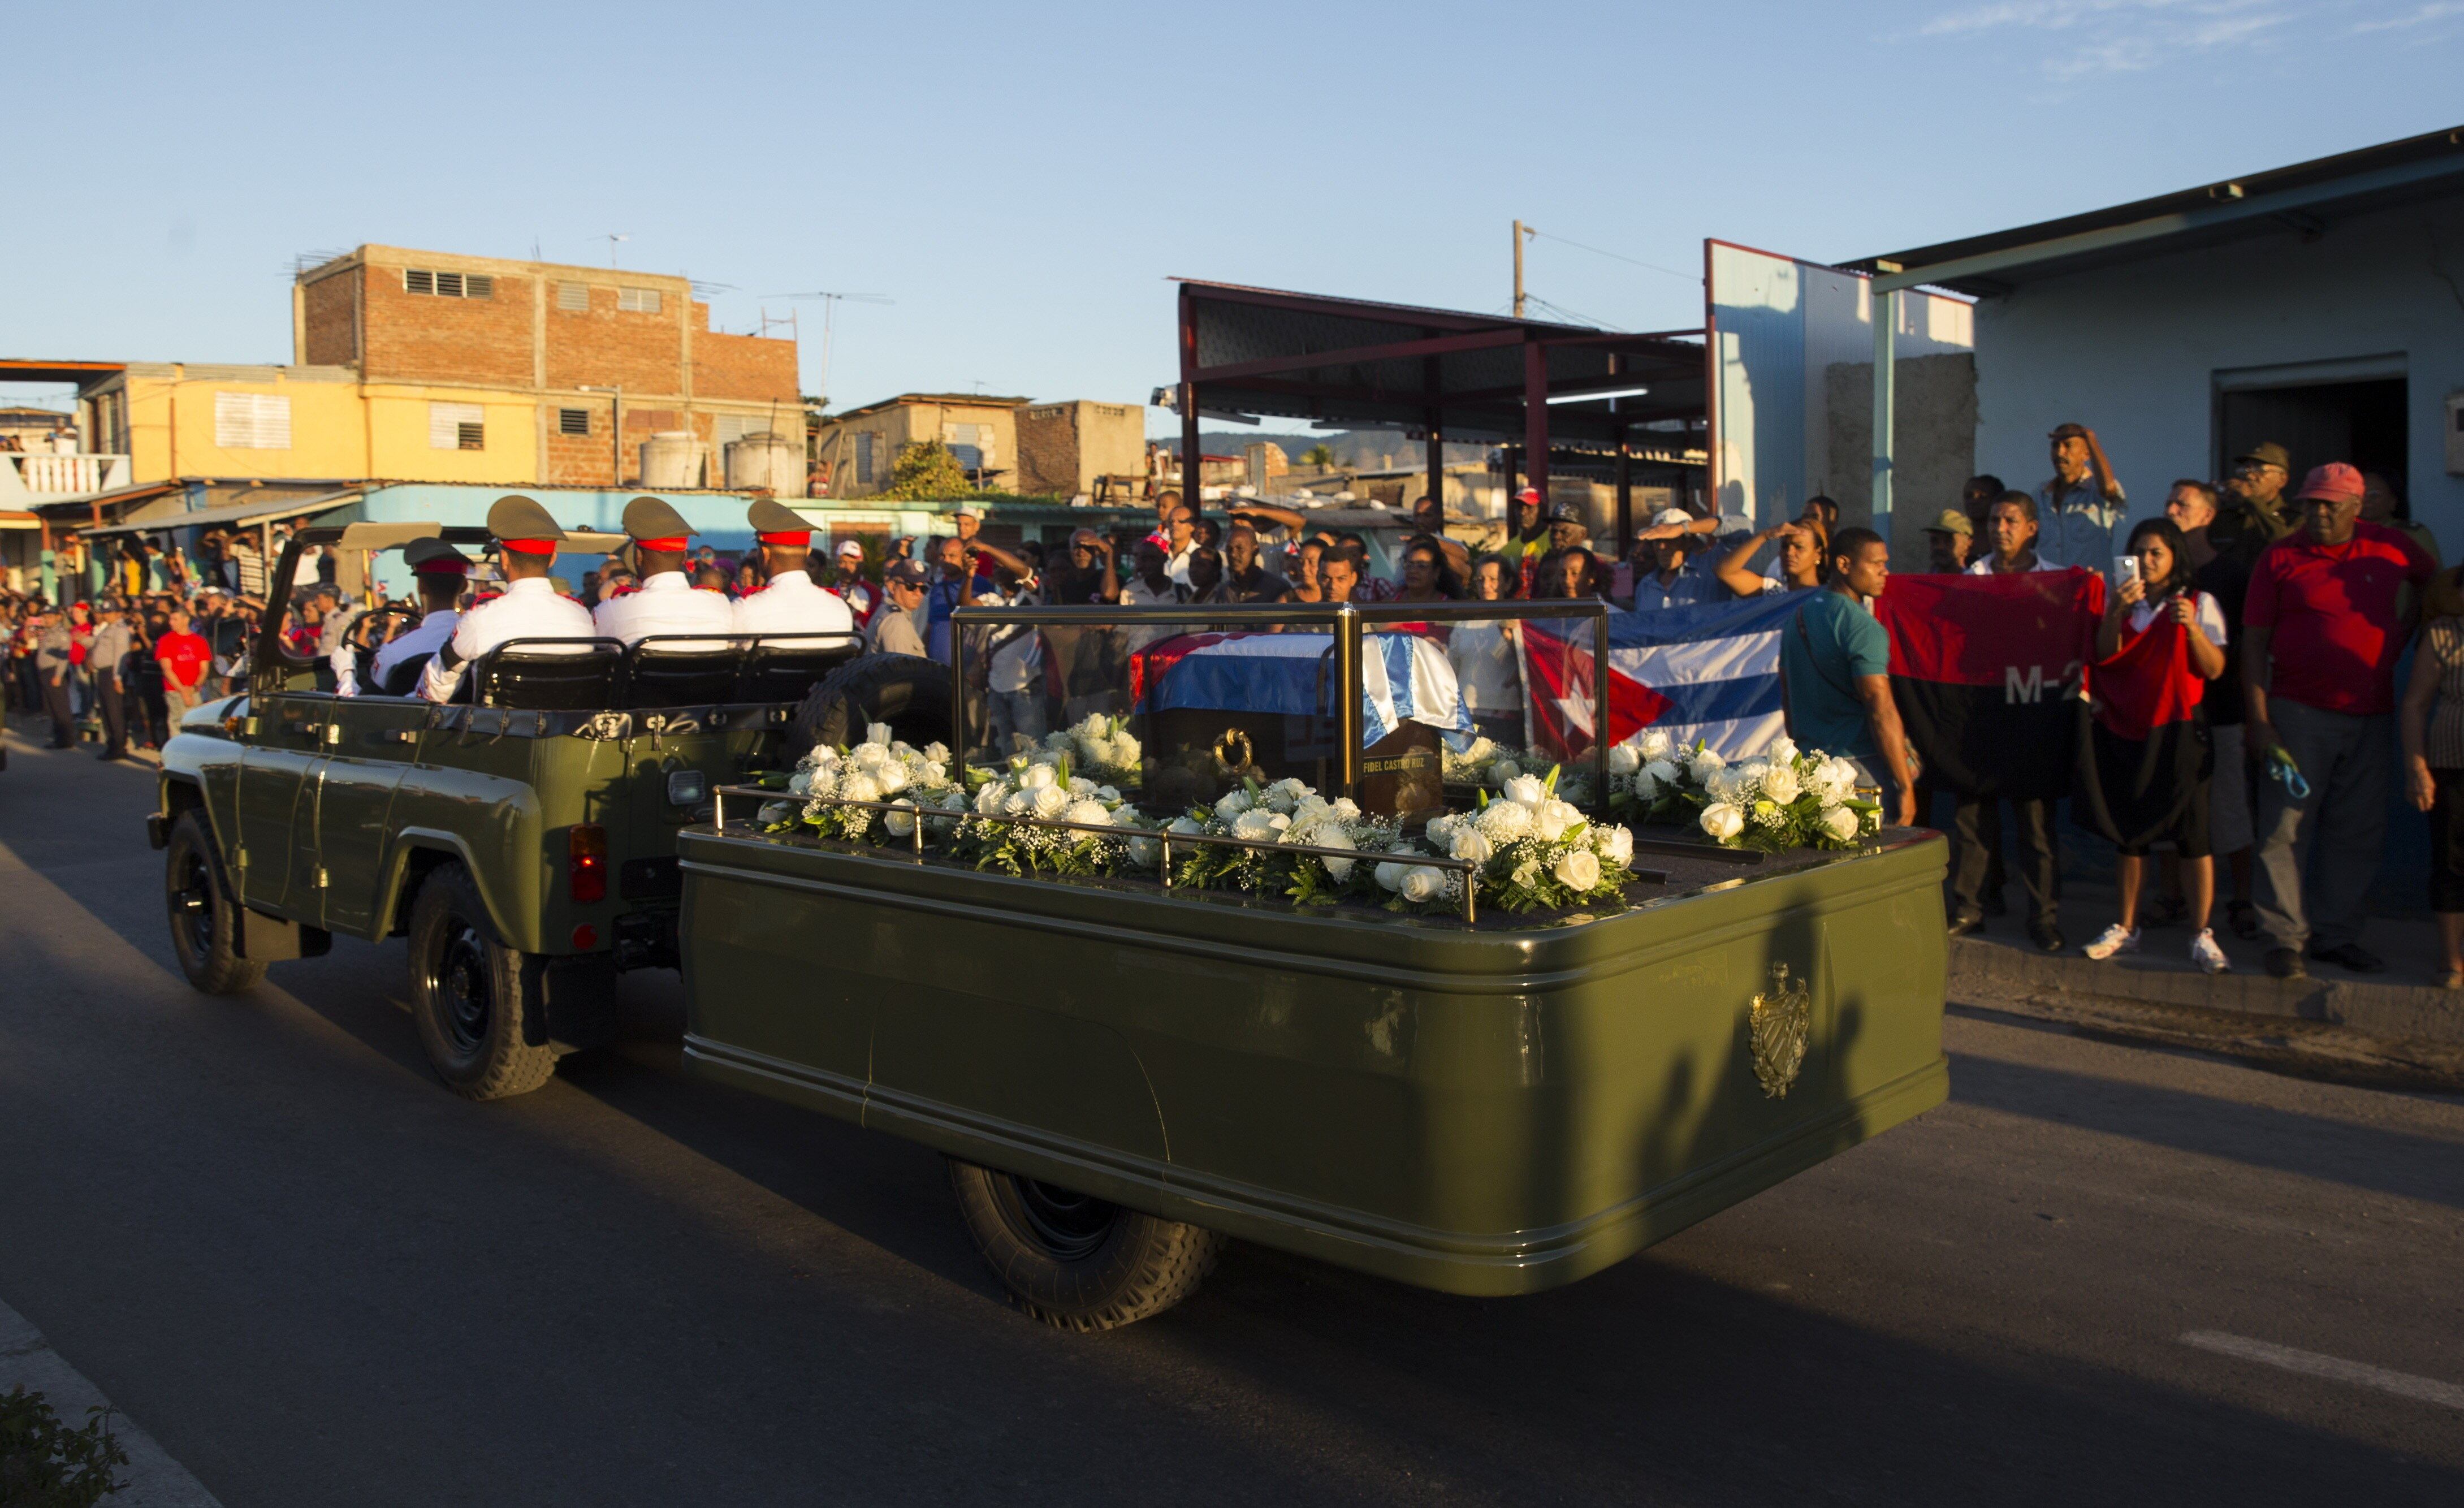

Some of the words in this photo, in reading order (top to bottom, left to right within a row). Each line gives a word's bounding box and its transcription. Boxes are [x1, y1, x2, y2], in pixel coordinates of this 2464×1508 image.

[1363, 761, 1382, 773] FIDEL
[1384, 758, 1410, 771] CASTRO
[1411, 757, 1425, 768] RUZ
